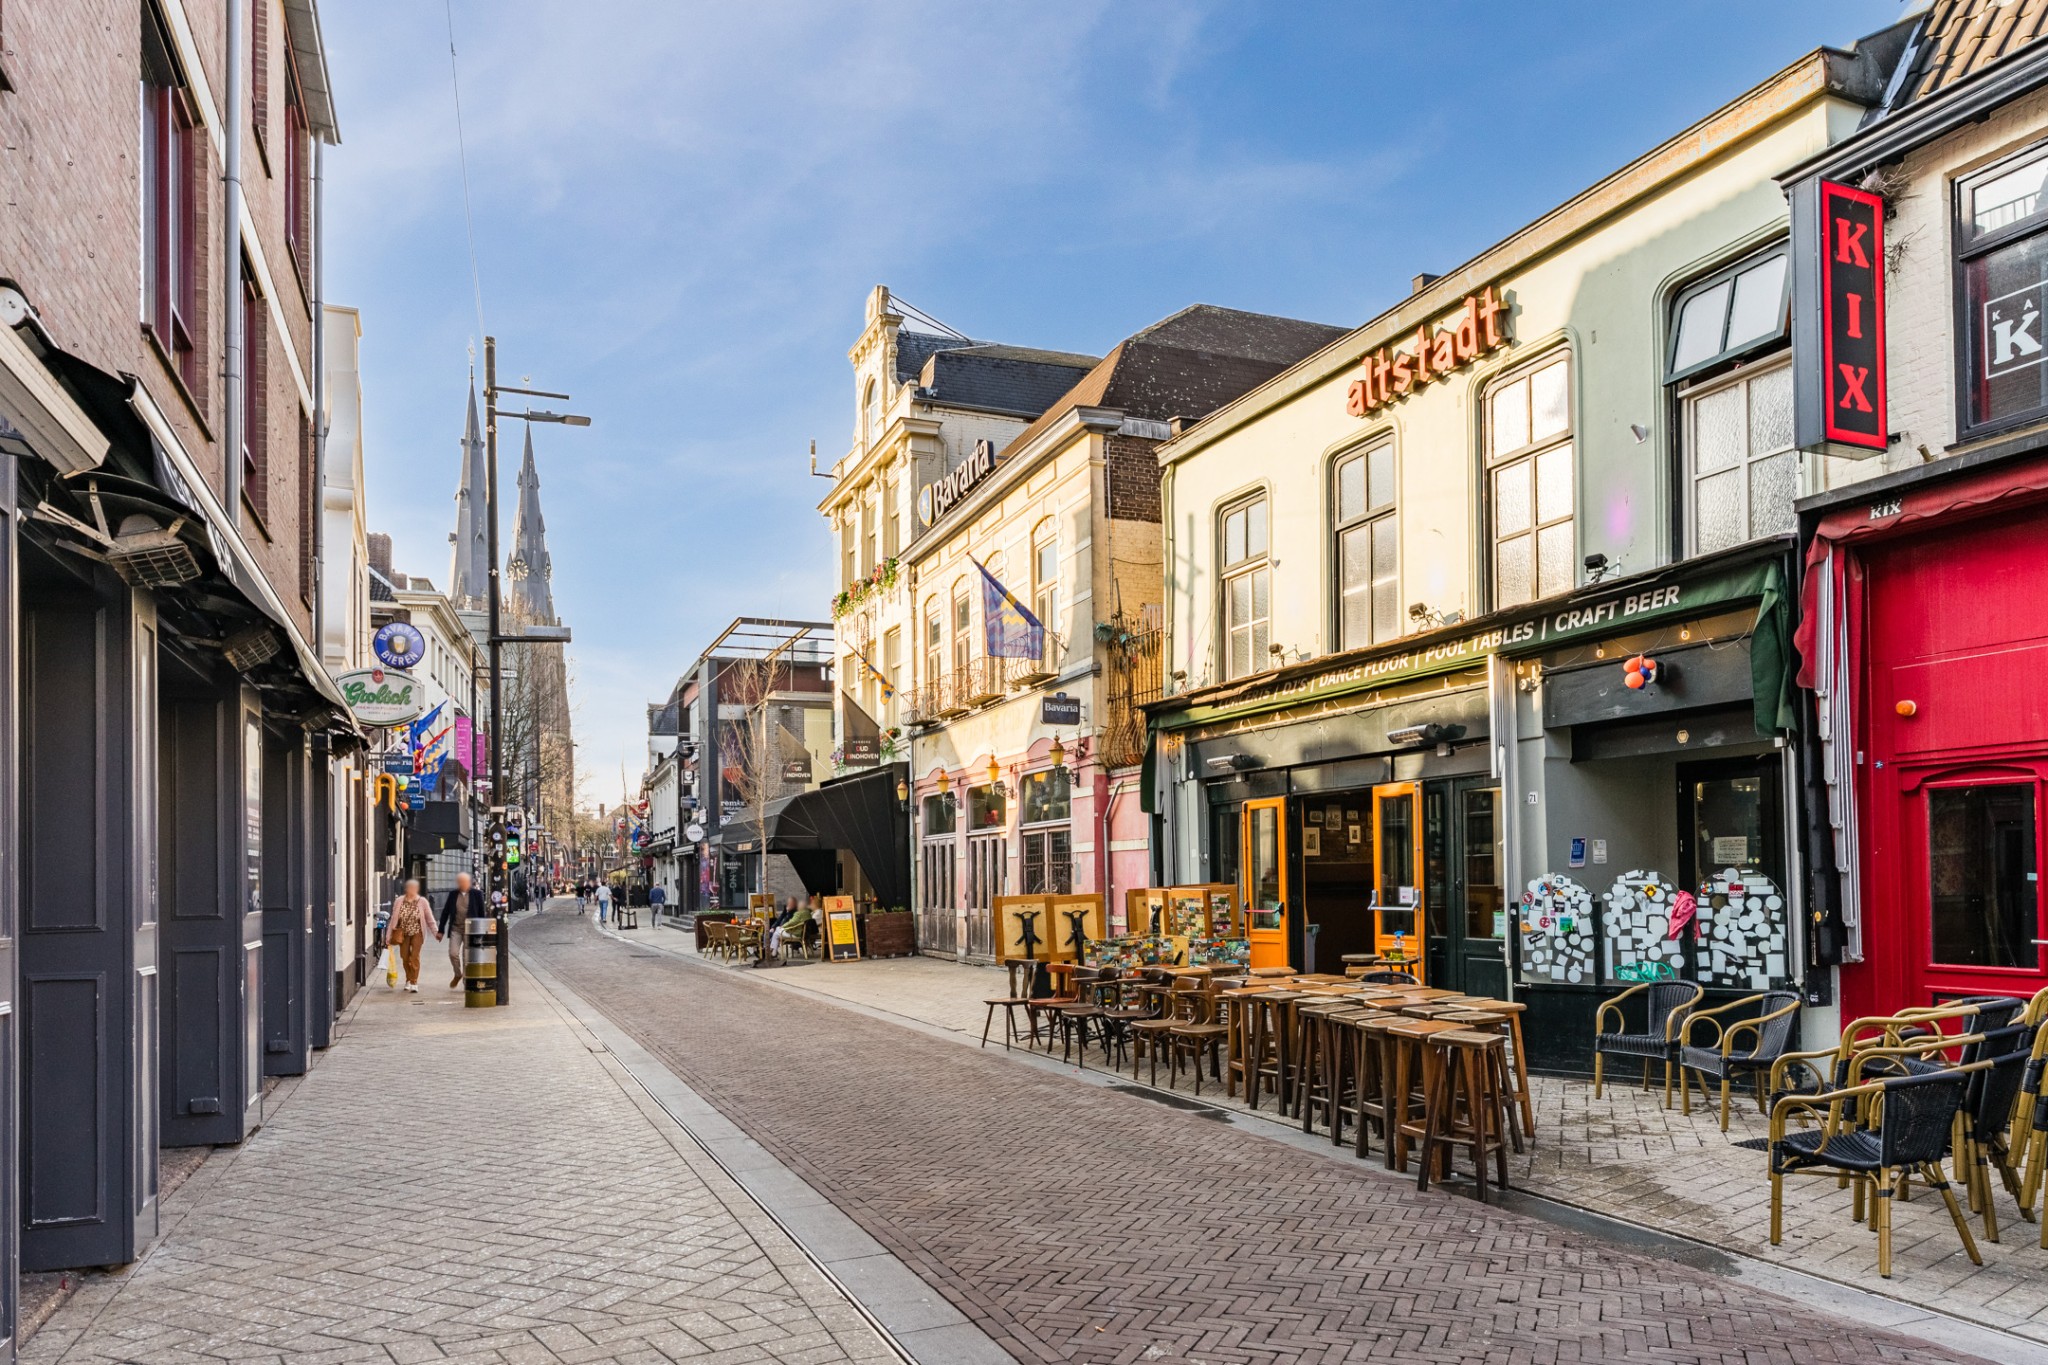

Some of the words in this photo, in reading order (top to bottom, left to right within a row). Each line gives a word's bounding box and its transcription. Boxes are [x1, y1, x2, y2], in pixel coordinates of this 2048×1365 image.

[1834, 217, 1874, 413] KIX
[1346, 285, 1500, 417] altstadt
[932, 438, 990, 520] Bavaria
[1870, 502, 1902, 520] KIX
[378, 624, 420, 642] BAVARIA
[1319, 662, 1362, 688] DANCE
[1364, 652, 1410, 677] FLOOR
[1425, 638, 1467, 663] POOL
[1471, 620, 1535, 652] TABLES
[1554, 600, 1620, 632] CRAFT
[1623, 585, 1681, 617] BEER
[381, 650, 419, 666] BIEREN
[342, 681, 412, 707] Grolsch
[1044, 702, 1079, 713] Bavaria
